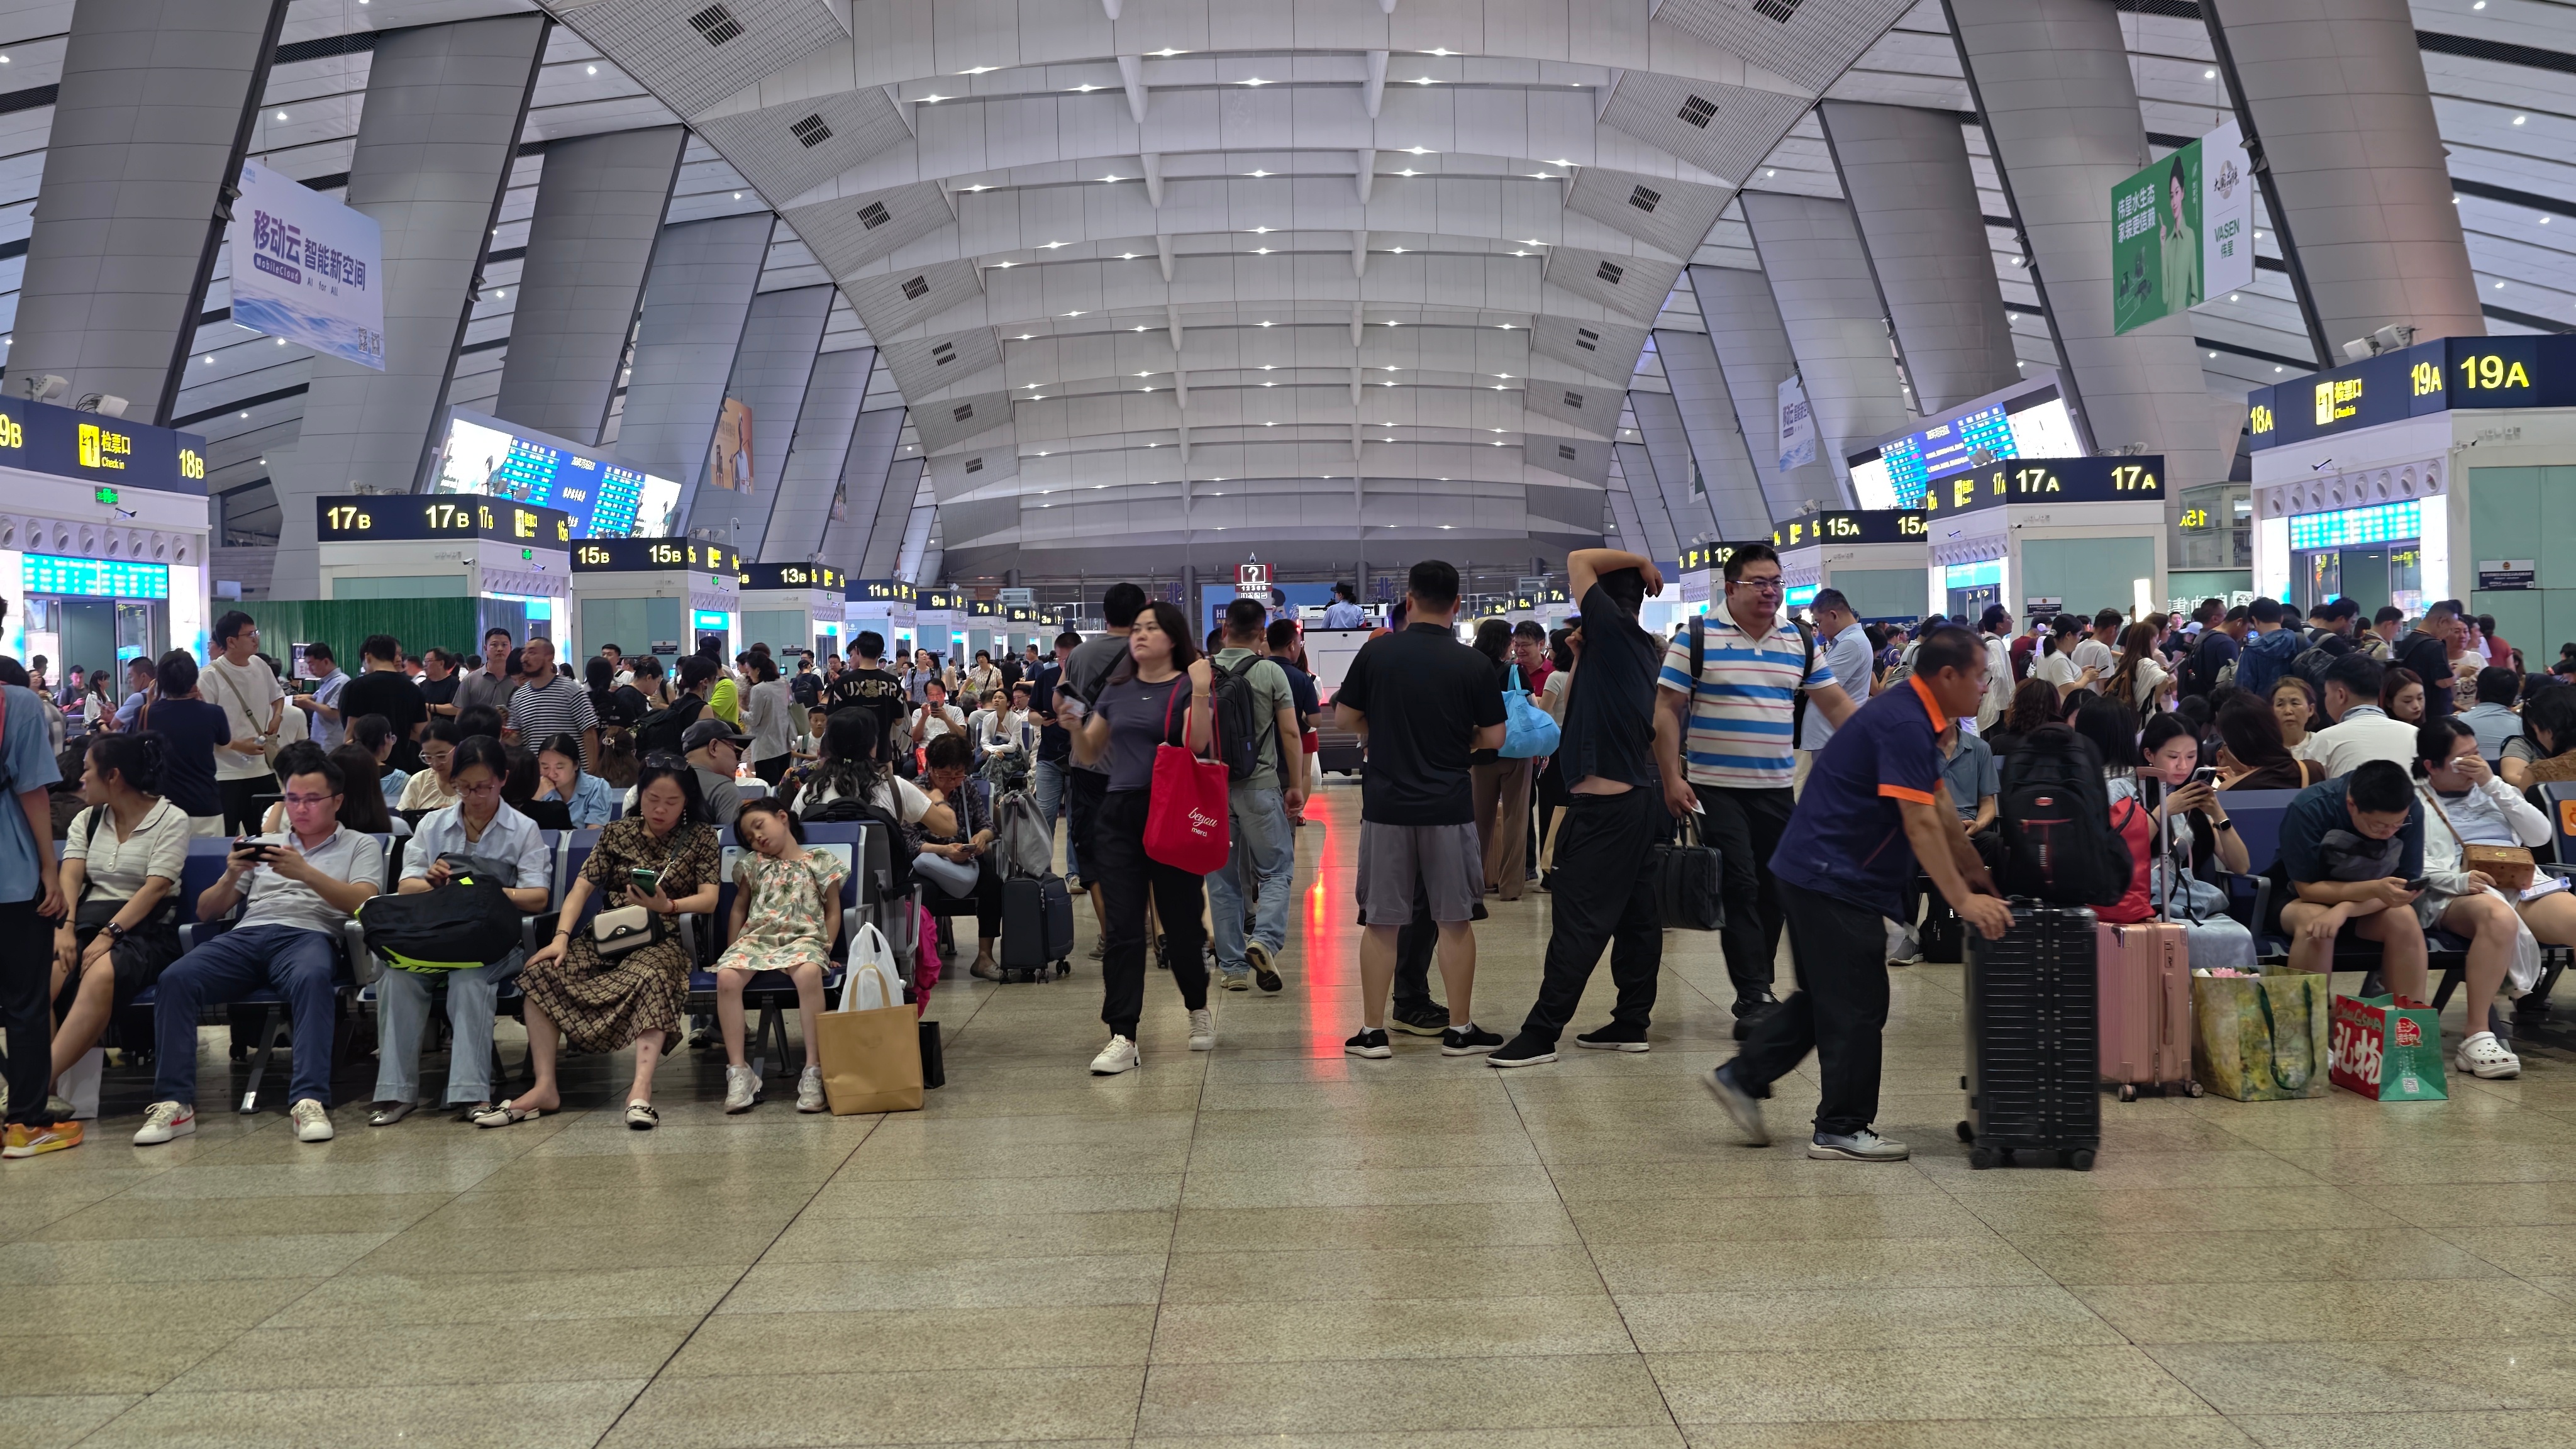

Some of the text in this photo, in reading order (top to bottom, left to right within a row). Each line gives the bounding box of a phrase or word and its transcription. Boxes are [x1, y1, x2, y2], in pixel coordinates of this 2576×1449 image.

[2118, 183, 2155, 220] 伟星水生态
[2118, 207, 2155, 243] 家装更信赖
[2214, 218, 2240, 243] VASEN
[253, 210, 366, 291] 移动云 智能新空间
[2221, 240, 2233, 259] 伟星
[256, 256, 299, 282] MobileCloud
[308, 277, 313, 287] AI
[2411, 362, 2442, 396] 19A
[2461, 356, 2529, 389] 19A
[2250, 406, 2273, 434] 18A
[101, 431, 130, 455] 检票口
[179, 449, 204, 479] 18B
[1993, 472, 2006, 495] 17A
[2016, 467, 2155, 492] 17A 17A
[1927, 490, 1938, 511] 16A
[328, 505, 470, 530] 17B 17B
[479, 506, 493, 529] 17B
[1828, 517, 1928, 536] 15A 15A
[558, 520, 569, 541] 16B
[579, 545, 681, 564] 15B 15B
[1715, 548, 1734, 562] 13
[781, 569, 806, 582] 13B
[869, 585, 889, 596] 11B
[1551, 591, 1564, 601] 7A
[1496, 605, 1506, 614] 3A
[1519, 599, 1531, 608] 5A
[2334, 1022, 2383, 1085] 礼物
